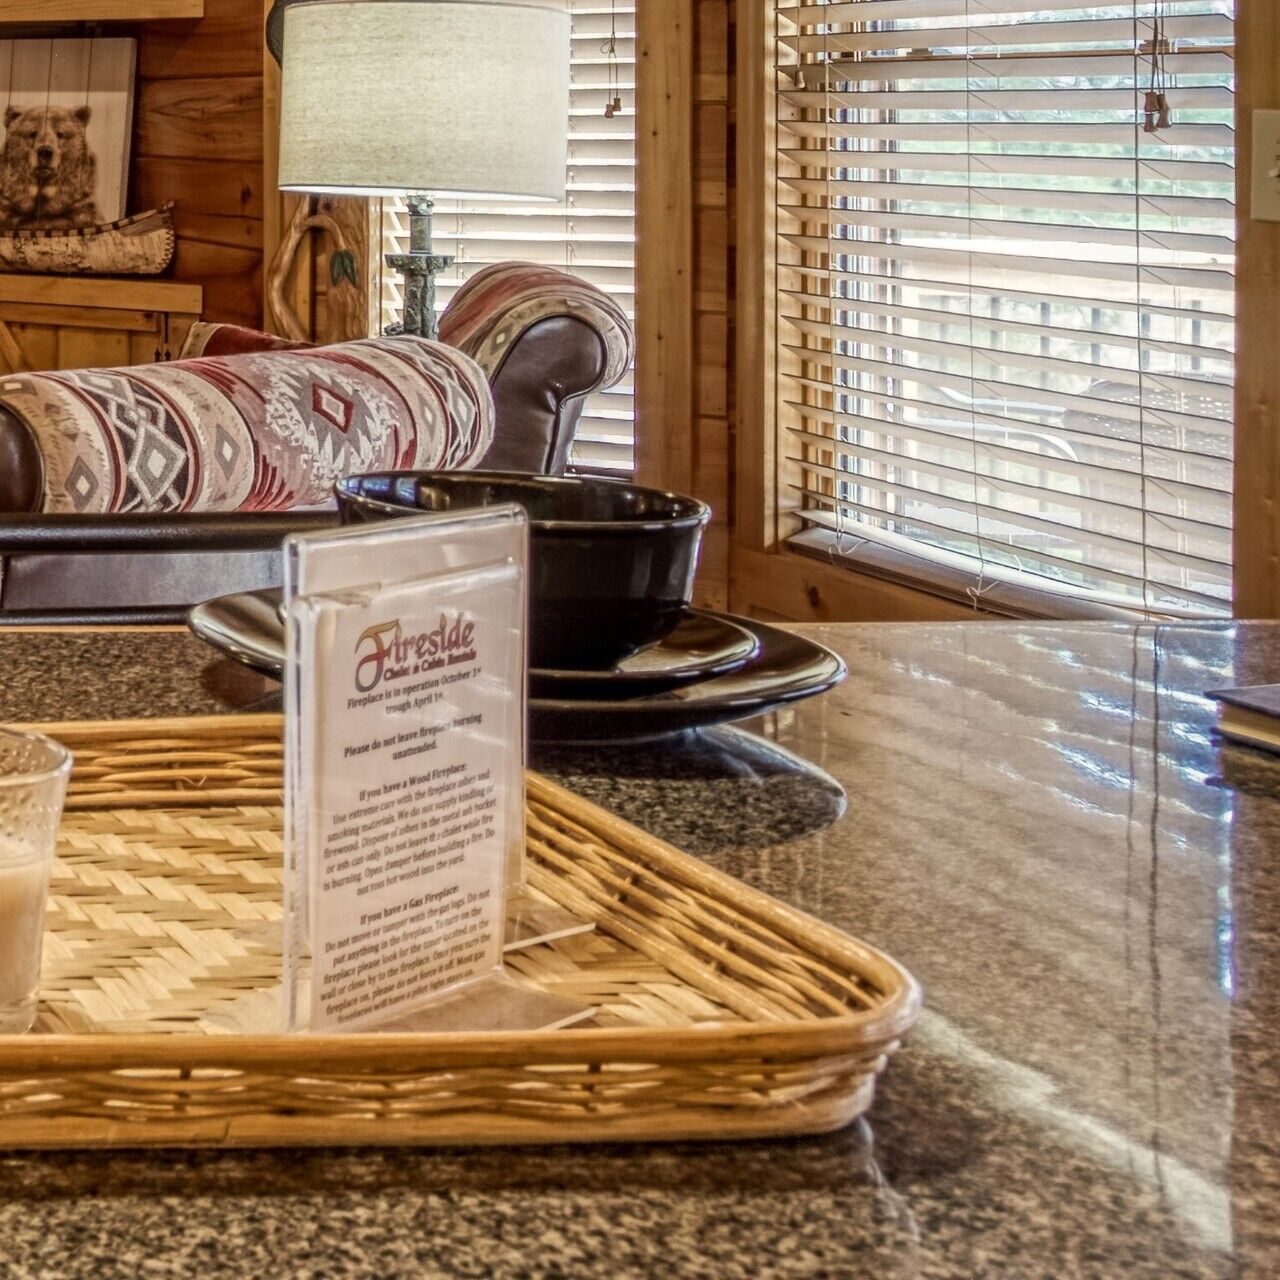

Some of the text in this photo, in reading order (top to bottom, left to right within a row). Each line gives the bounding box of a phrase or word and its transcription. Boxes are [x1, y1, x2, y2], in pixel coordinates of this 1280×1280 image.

[355, 612, 475, 693] Fireside
[347, 694, 383, 710] Fireplace
[385, 690, 392, 700] is
[394, 687, 401, 697] in
[403, 679, 439, 696] operation
[441, 671, 470, 685] October
[413, 694, 432, 709] April
[344, 745, 369, 758] Please
[372, 740, 381, 750] do
[384, 736, 396, 747] not
[398, 732, 418, 743] leave
[453, 714, 482, 728] burning
[333, 815, 347, 825] Use
[348, 805, 378, 820] extreme
[397, 792, 412, 806] with
[415, 789, 426, 800] the
[427, 781, 457, 796] fireplace
[478, 769, 490, 781] and
[359, 791, 366, 802] If
[367, 789, 381, 802] you
[383, 783, 401, 794] have
[403, 781, 407, 789] a
[409, 772, 431, 787] Wood
[328, 827, 360, 843] smoking
[398, 811, 409, 821] We
[410, 807, 420, 817] do
[422, 802, 433, 813] not
[435, 795, 457, 809] supply
[459, 787, 485, 802] kindling
[362, 833, 389, 847] Dispose
[399, 823, 418, 836] ashes
[421, 819, 427, 829] in
[429, 815, 440, 826] the
[474, 798, 496, 812] bucket
[326, 866, 335, 874] or
[337, 858, 349, 871] ash
[384, 846, 394, 856] Do
[395, 841, 407, 852] not
[409, 836, 428, 848] leave
[365, 866, 383, 878] Open
[385, 857, 412, 872] damper
[414, 849, 436, 863] before
[438, 839, 465, 855] building
[485, 829, 495, 840] Do
[387, 876, 398, 887] hot
[399, 868, 420, 883] wood
[421, 865, 435, 876] into
[437, 860, 447, 871] the
[325, 943, 336, 953] Do
[338, 937, 350, 949] not
[352, 931, 371, 944] move
[373, 928, 381, 937] or
[467, 894, 477, 904] Do
[478, 889, 490, 900] not
[360, 915, 367, 926] If
[368, 913, 382, 926] you
[384, 906, 401, 918] have
[403, 903, 408, 911] a
[409, 898, 423, 909] Gas
[324, 967, 356, 985] fireplace
[358, 959, 381, 975] please
[382, 950, 397, 964] look
[410, 943, 421, 954] the
[333, 952, 346, 967] put
[347, 943, 379, 959] anything
[381, 938, 388, 948] in
[390, 934, 400, 945] the
[321, 987, 336, 1001] wall
[368, 974, 377, 985] by
